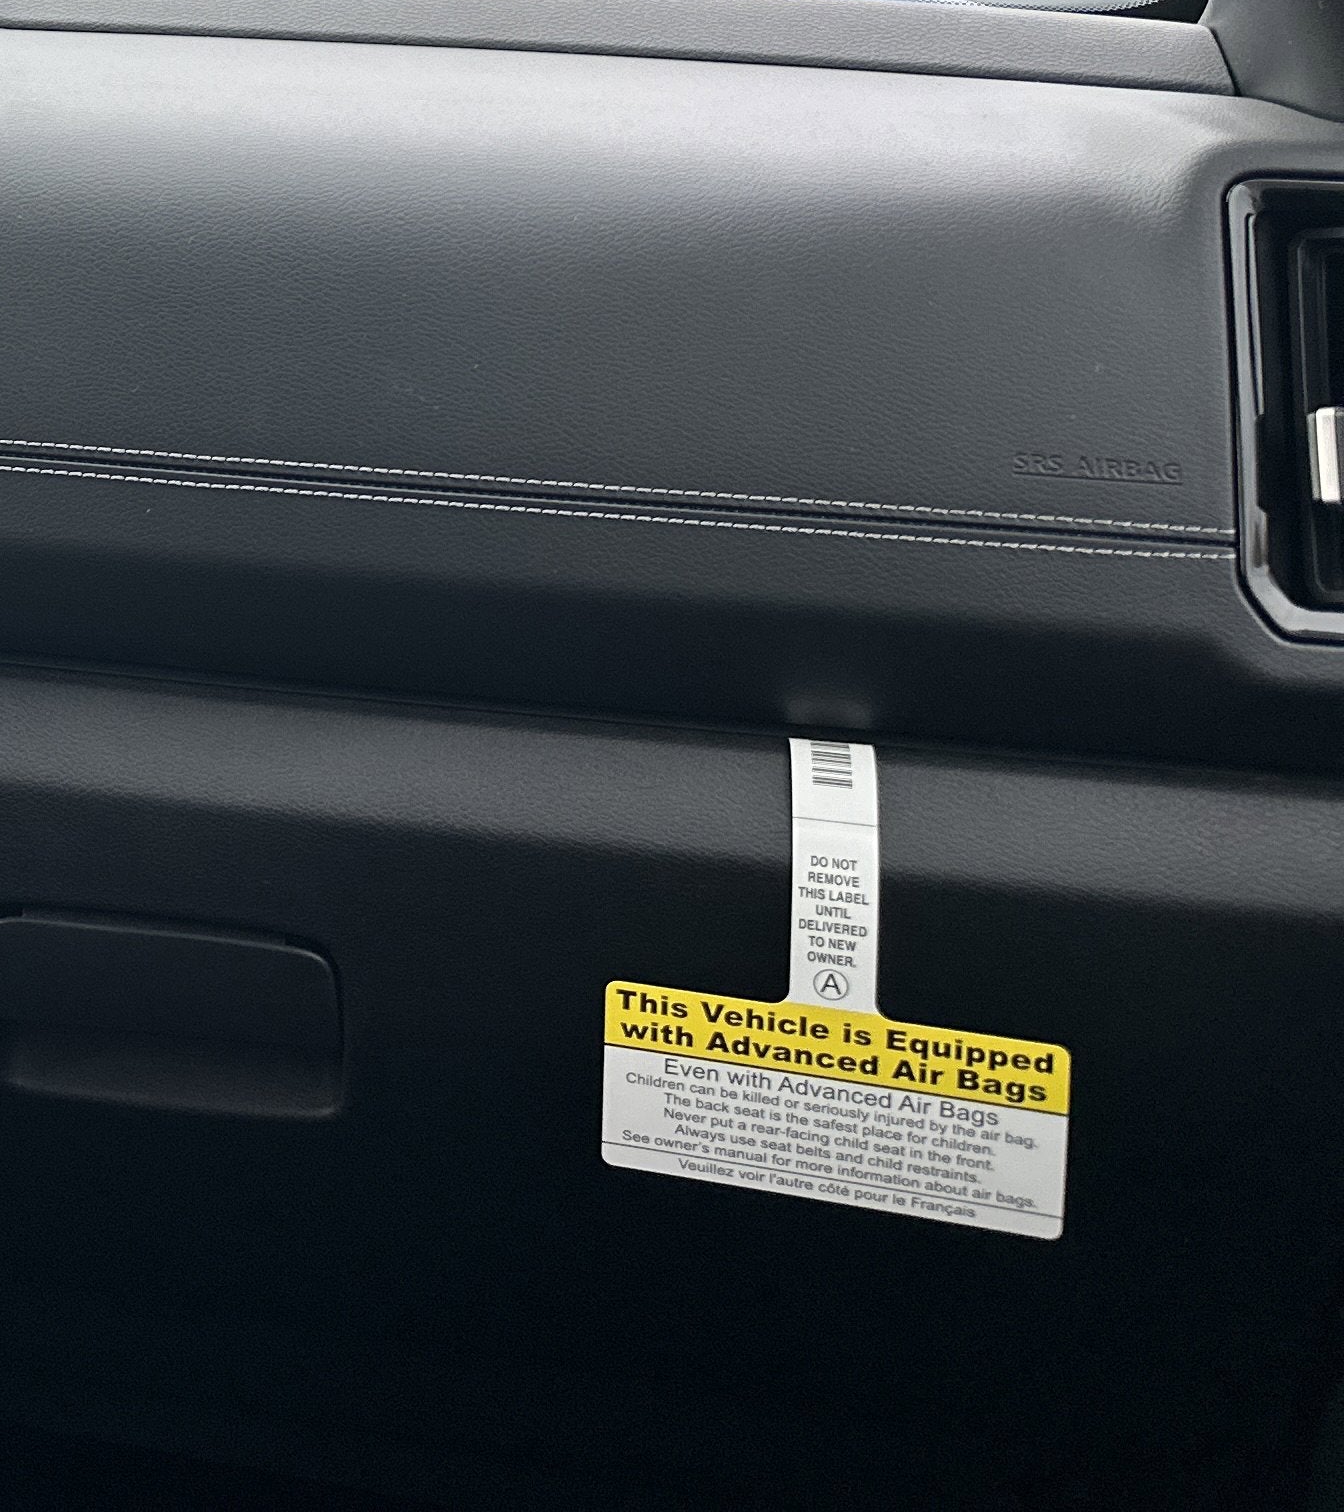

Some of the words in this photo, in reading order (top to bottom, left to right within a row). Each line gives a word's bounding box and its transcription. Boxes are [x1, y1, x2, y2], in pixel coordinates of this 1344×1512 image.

[1012, 451, 1062, 473] SRS
[1078, 454, 1183, 481] AIRBAG
[808, 871, 860, 888] REMOVE
[811, 856, 828, 868] DO
[832, 858, 857, 872] NOT
[798, 886, 825, 901] THIS
[829, 889, 869, 905] LABEL
[816, 906, 851, 920] UNTIL
[798, 918, 868, 938] DELIVERED
[808, 936, 824, 948] TO
[828, 938, 856, 952] NEW
[807, 952, 857, 968] OWNER.
[616, 989, 689, 1019] This
[700, 1001, 829, 1040] Vehicle
[843, 1023, 872, 1046] is
[885, 1028, 1054, 1074] Equipped
[620, 1021, 694, 1048] with
[705, 1031, 880, 1076] Advanced
[892, 1059, 945, 1085] Air
[956, 1069, 1048, 1104] Bags
[664, 1058, 720, 1082] Even
[727, 1072, 771, 1089] with
[777, 1076, 892, 1109] Advanced
[898, 1095, 931, 1115] Air
[940, 1101, 999, 1127] Bags
[626, 1072, 685, 1092] Children
[690, 1084, 715, 1096] can
[720, 1088, 738, 1100] be
[742, 1090, 780, 1107] killed
[784, 1098, 799, 1108] or
[803, 1100, 869, 1122] seriously
[874, 1111, 925, 1130] injured
[930, 1119, 948, 1135] by
[953, 1122, 976, 1138] the
[980, 1127, 1001, 1140] air
[1005, 1132, 1038, 1150] bag.
[663, 1108, 706, 1125] Never
[710, 1116, 734, 1132] put
[737, 1121, 747, 1130] a
[751, 1123, 829, 1147] rear-facing
[834, 1134, 869, 1151] child
[873, 1142, 906, 1157] seat
[910, 1146, 923, 1159] in
[928, 1148, 951, 1164] the
[956, 1154, 994, 1171] front.
[664, 1092, 691, 1107] The
[696, 1096, 729, 1113] back
[734, 1105, 766, 1119] seat
[770, 1109, 781, 1122] is
[786, 1111, 808, 1126] the
[813, 1116, 858, 1135] safest
[862, 1124, 903, 1142] place
[907, 1130, 927, 1145] for
[931, 1134, 995, 1157] children.
[622, 1129, 650, 1144] See
[654, 1136, 710, 1154] owner's
[714, 1145, 767, 1163] manual
[771, 1154, 792, 1166] for
[795, 1161, 833, 1174] more
[838, 1161, 920, 1189] information
[925, 1178, 968, 1197] about
[972, 1188, 992, 1201] air
[996, 1192, 1036, 1209] bags.
[675, 1124, 726, 1143] Always
[730, 1133, 756, 1146] use
[760, 1138, 792, 1152] seat
[796, 1141, 831, 1160] belts
[836, 1148, 863, 1165] and
[868, 1155, 903, 1171] child
[907, 1162, 980, 1184] restraints.
[678, 1158, 734, 1177] Veuillez
[739, 1168, 764, 1183] voir
[769, 1173, 814, 1191] l'autre
[818, 1180, 850, 1197] côté
[854, 1189, 888, 1205] pour
[892, 1192, 906, 1207] le
[911, 1197, 976, 1218] Français
